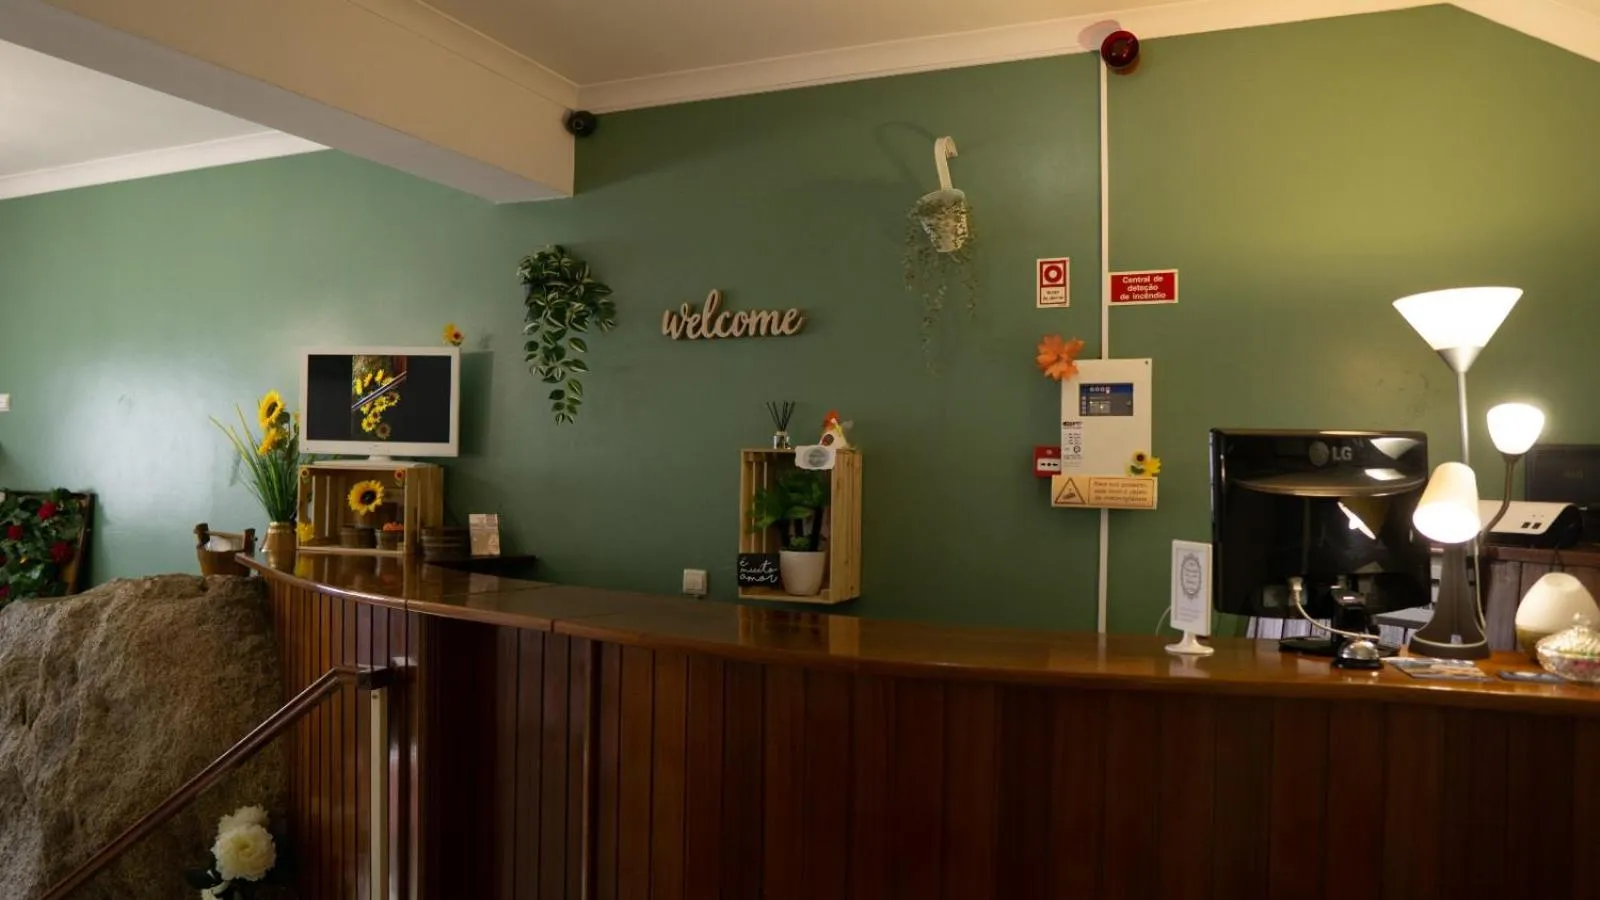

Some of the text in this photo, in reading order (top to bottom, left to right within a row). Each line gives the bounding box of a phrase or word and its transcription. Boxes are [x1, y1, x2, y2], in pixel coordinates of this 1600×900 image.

[1122, 275, 1151, 284] Central
[1120, 291, 1167, 301] de incêndio
[661, 288, 805, 340] welcome
[1332, 446, 1353, 460] LG
[740, 573, 778, 584] amor
